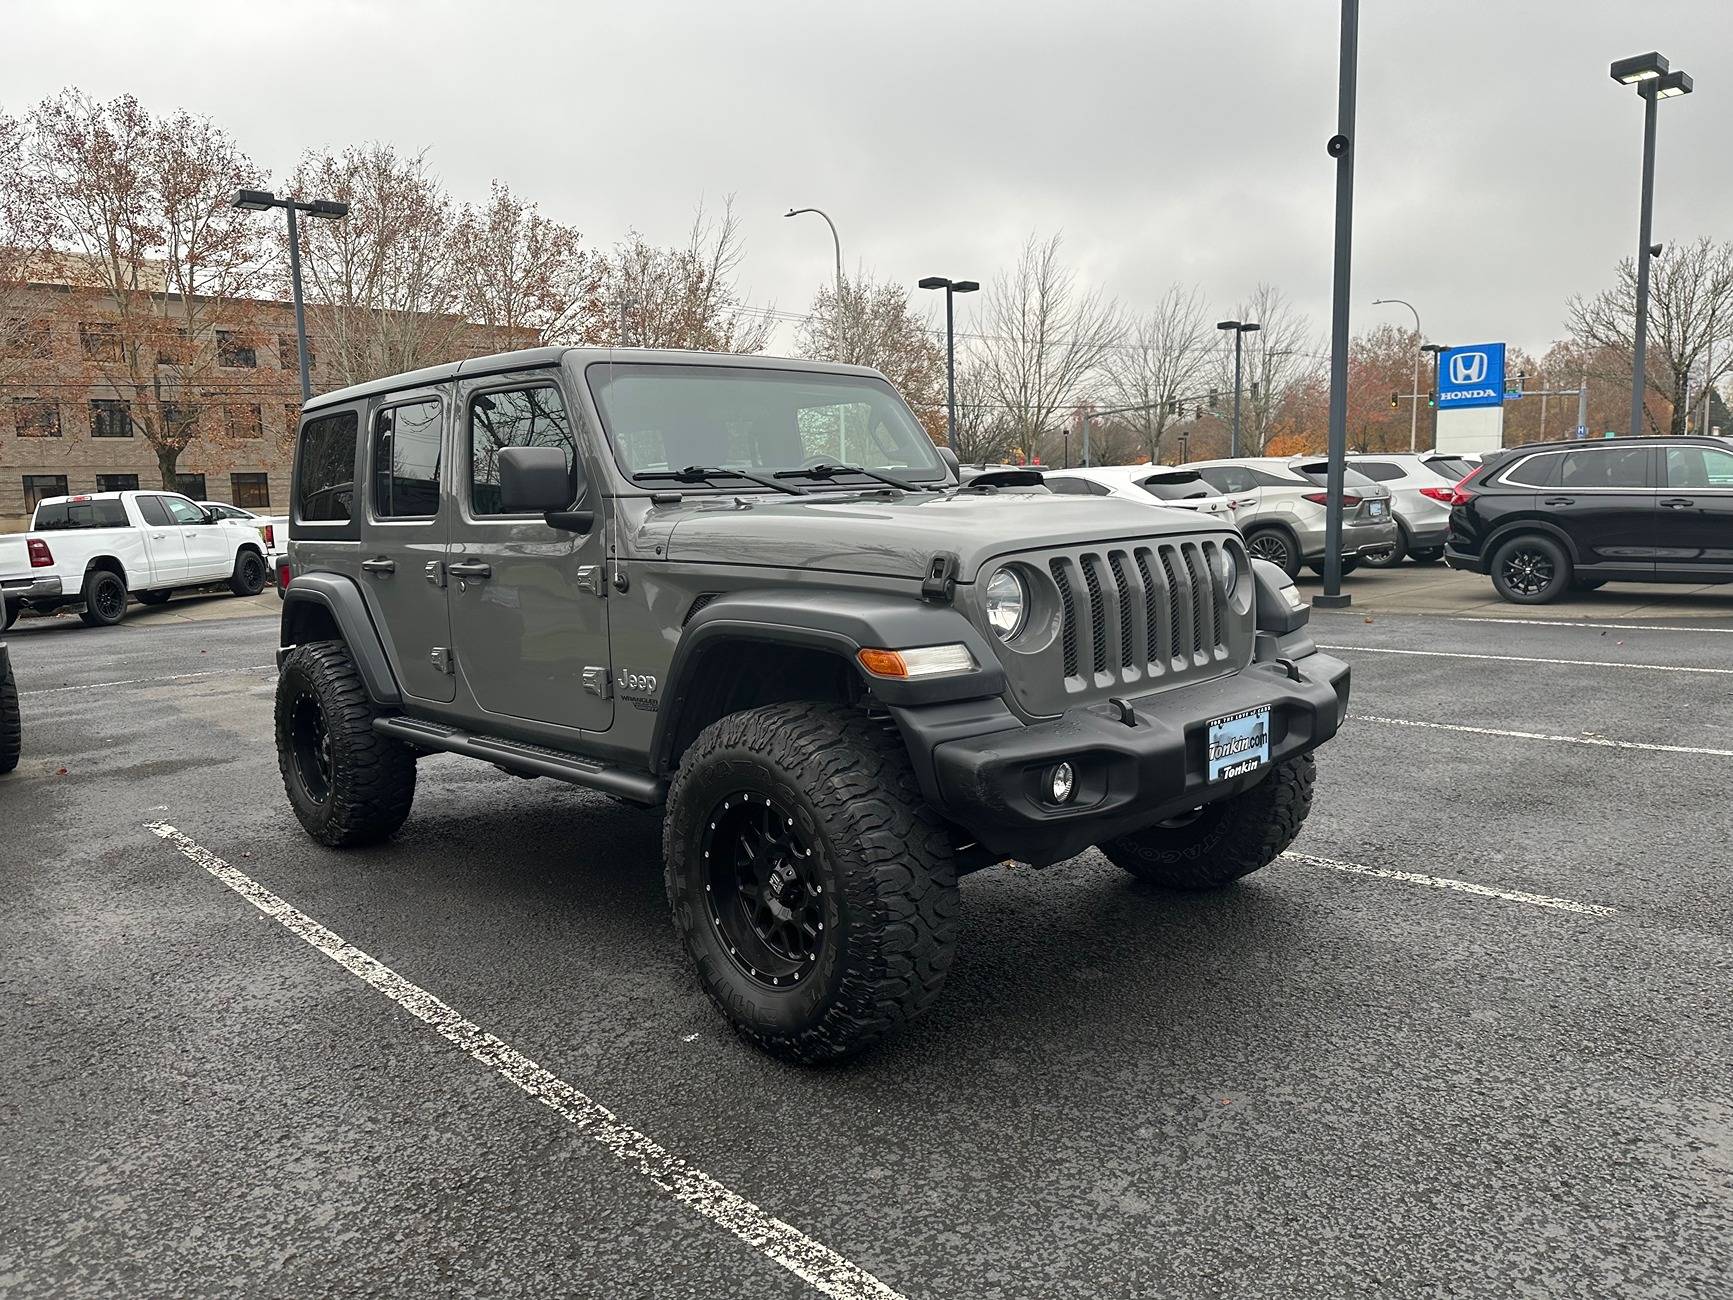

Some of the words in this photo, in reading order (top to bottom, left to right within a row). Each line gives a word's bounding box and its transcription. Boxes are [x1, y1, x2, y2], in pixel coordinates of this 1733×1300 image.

[1440, 389, 1496, 400] HONDA
[617, 668, 657, 695] Jeep
[1209, 732, 1268, 762] Tonkin.com
[1223, 760, 1259, 780] Tonkin
